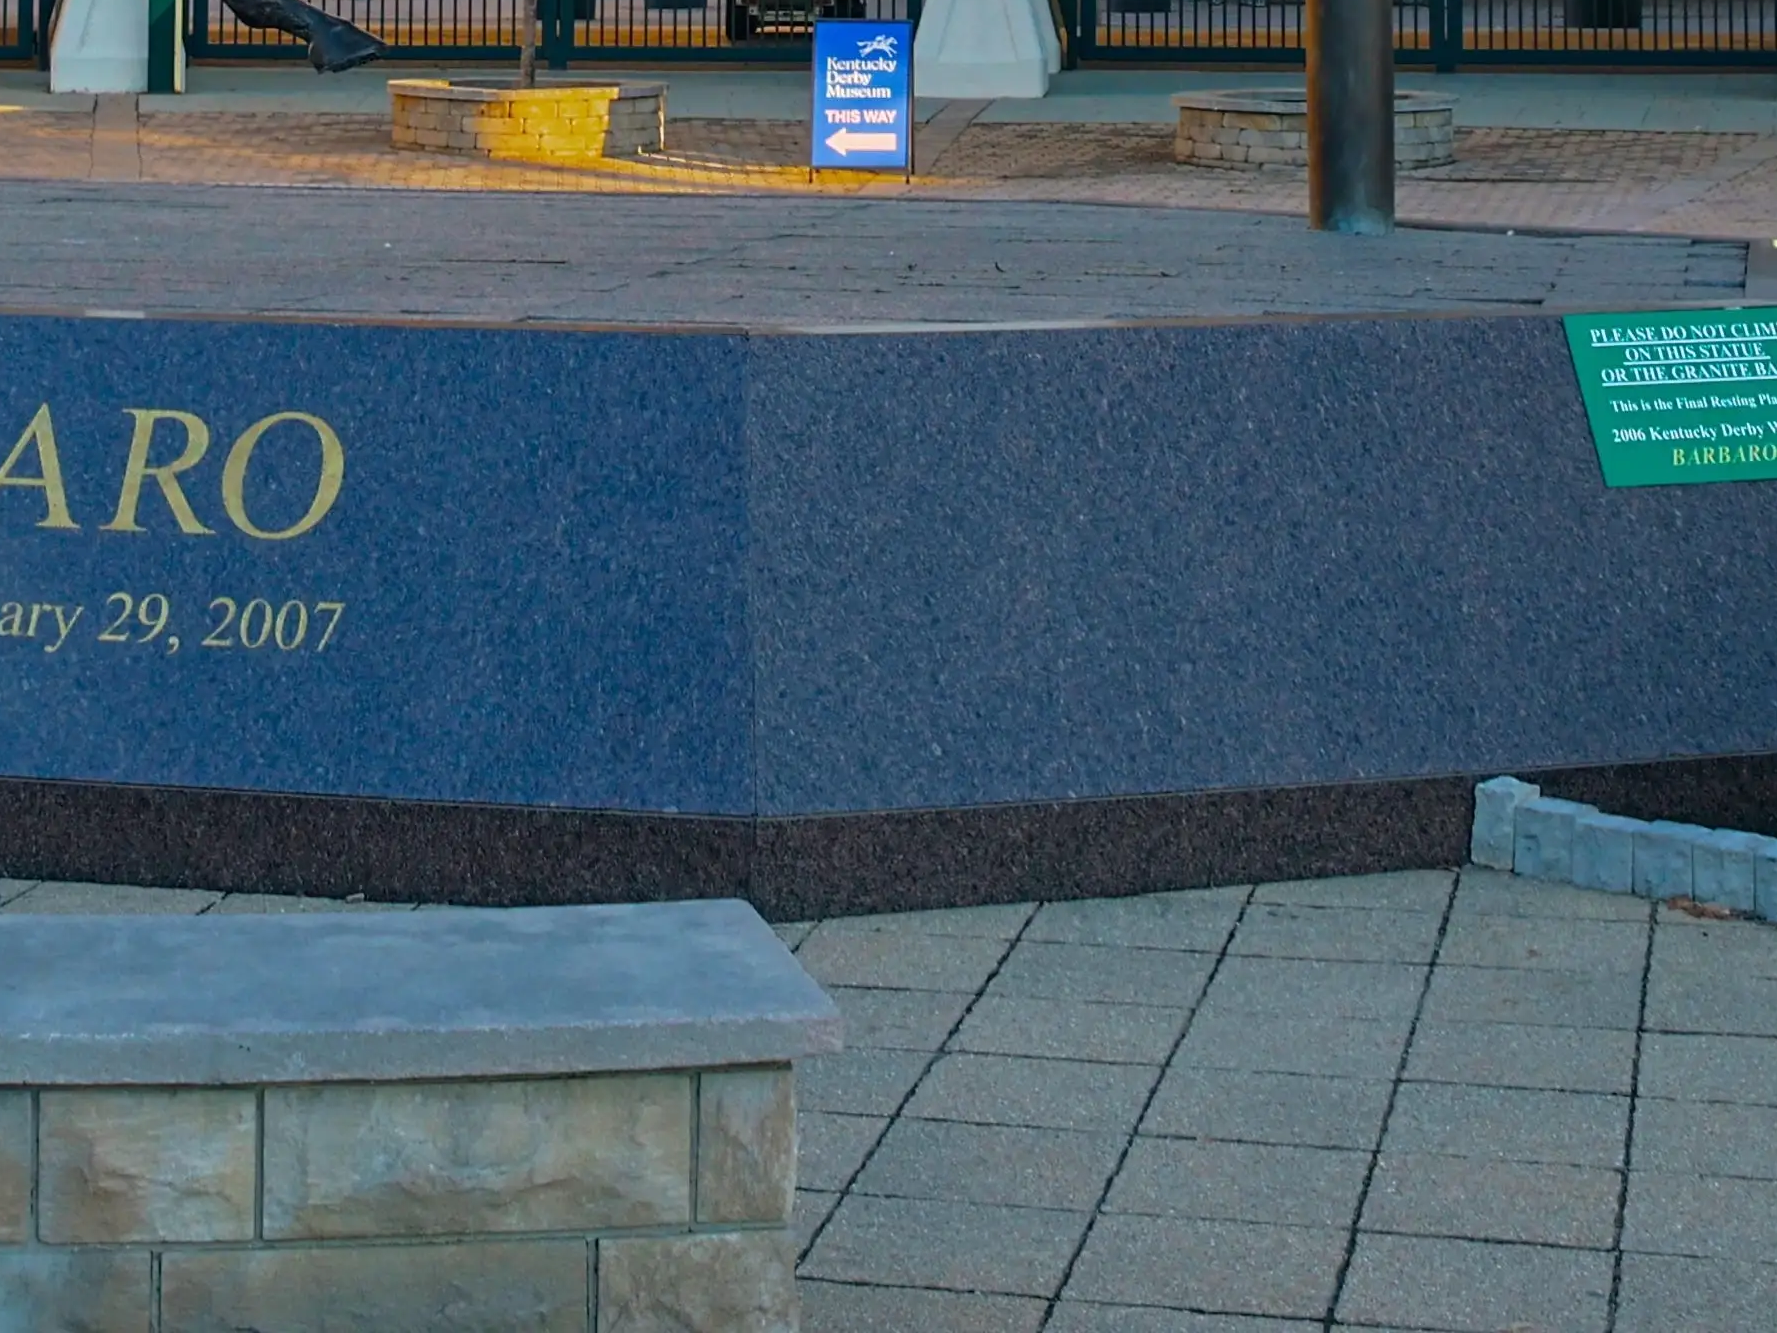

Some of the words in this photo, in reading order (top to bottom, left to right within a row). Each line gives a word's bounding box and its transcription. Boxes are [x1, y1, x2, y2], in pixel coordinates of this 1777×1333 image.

[826, 57, 897, 73] Kentucky
[826, 71, 872, 86] Derby
[826, 85, 891, 98] Museum
[825, 110, 861, 123] THIS
[864, 110, 897, 123] WAY
[1590, 328, 1655, 343] PLEASE
[1662, 326, 1686, 340] DO
[1690, 324, 1726, 339] NOT
[1625, 348, 1651, 361] ON
[1657, 345, 1696, 360] THIS
[1701, 342, 1765, 358] STATUE
[1601, 368, 1628, 383] OR
[1630, 366, 1668, 381] THE
[1672, 363, 1752, 380] GRANITE
[1610, 399, 1639, 412] This
[1642, 398, 1652, 411] is
[1654, 397, 1673, 410] the
[1676, 396, 1708, 410] Final
[1711, 394, 1756, 409] Resting
[1612, 428, 1647, 443] 2006
[1650, 424, 1718, 442] Kentucky
[1720, 423, 1764, 439] Derby
[100, 592, 181, 656] 29,
[202, 598, 346, 652] 2007
